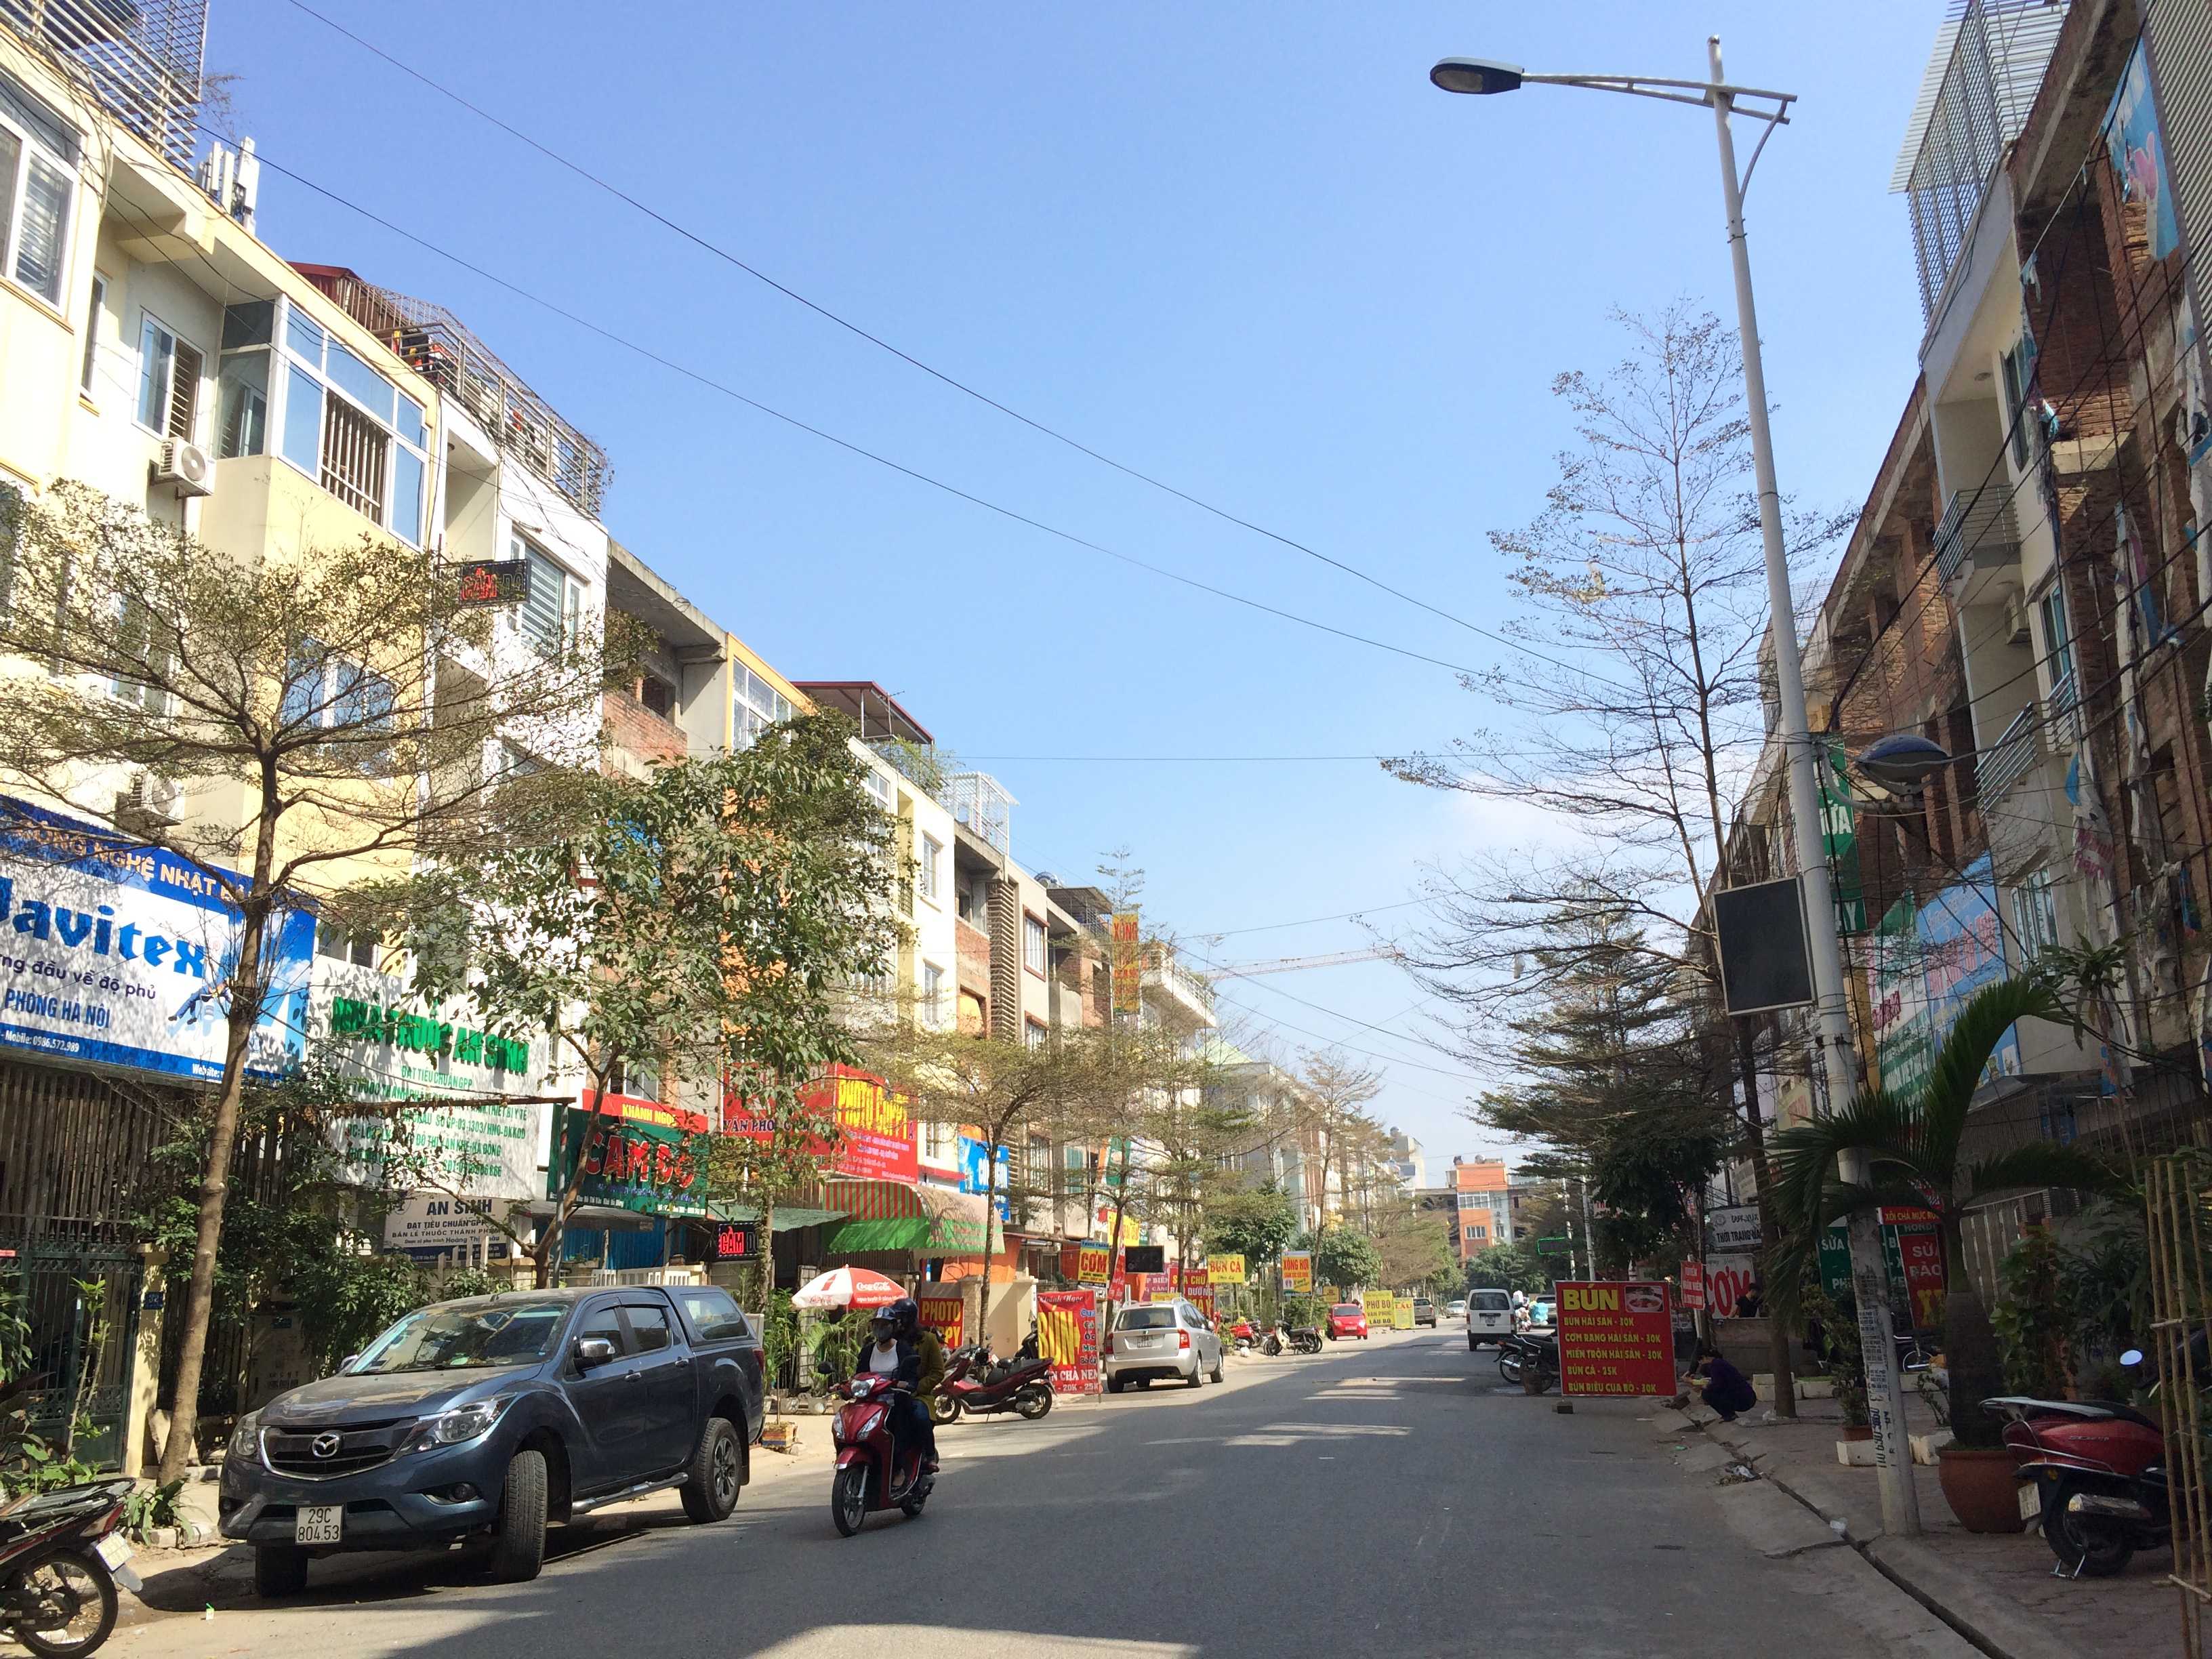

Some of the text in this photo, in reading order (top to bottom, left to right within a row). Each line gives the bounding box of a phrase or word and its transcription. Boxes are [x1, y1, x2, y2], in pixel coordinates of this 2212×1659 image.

[93, 842, 155, 880] NGHỆ
[160, 863, 217, 897] NHẬT
[32, 960, 66, 980] đầu
[73, 969, 95, 986] về
[99, 976, 120, 995] độ
[125, 983, 157, 1000] phủ
[5, 987, 111, 1032] PHÒNG HÀ NỘI
[5, 1030, 33, 1046] Mobile:
[384, 998, 454, 1057] THUỐC
[453, 1026, 484, 1067] AN
[459, 1076, 473, 1088] GPP
[622, 1103, 653, 1120] KHÁNH
[426, 1201, 449, 1216] AN
[1904, 1223, 1936, 1233] HOND
[720, 1225, 744, 1254] CẦM
[1822, 1235, 1845, 1251] SỬA
[1912, 1241, 1938, 1258] SỬ
[1080, 1250, 1107, 1274] CƠM
[1563, 1284, 1619, 1311] BÚN
[922, 1300, 961, 1322] PHOTO
[308, 1508, 331, 1524] 29C
[298, 1525, 340, 1541] 804.53
